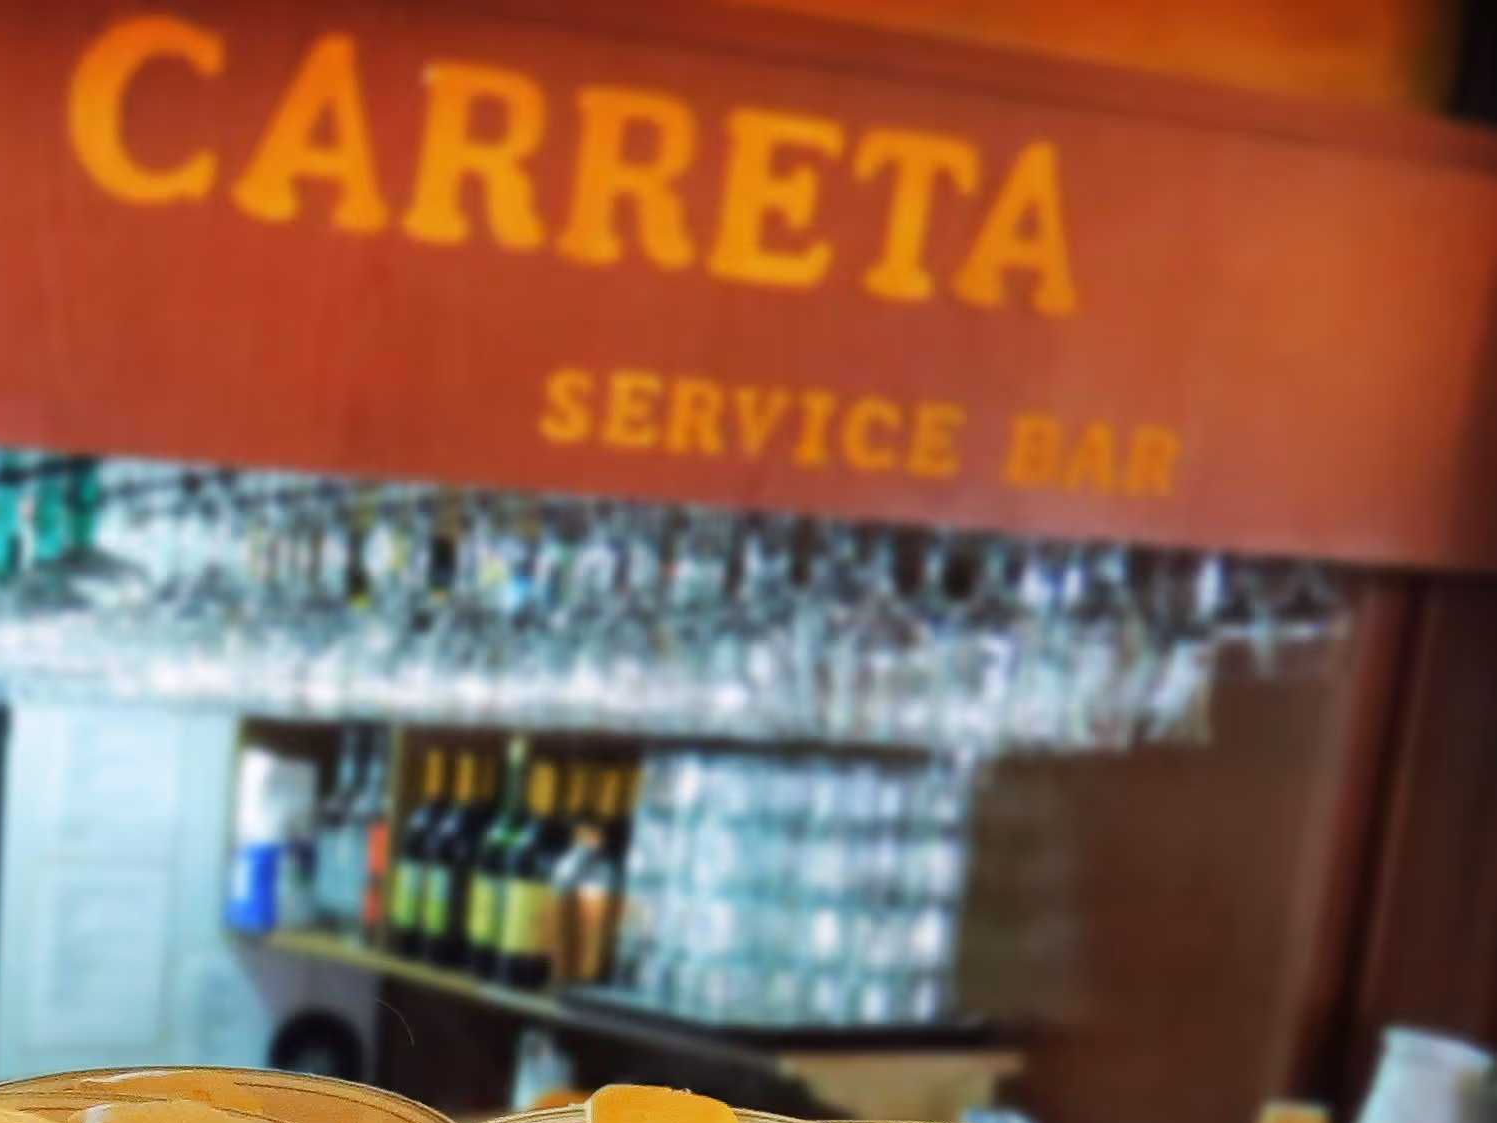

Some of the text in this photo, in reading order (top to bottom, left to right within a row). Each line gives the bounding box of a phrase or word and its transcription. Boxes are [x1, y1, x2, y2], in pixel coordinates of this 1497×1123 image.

[70, 16, 1080, 317] CARRETA
[539, 367, 1180, 496] SERVICE BAR
